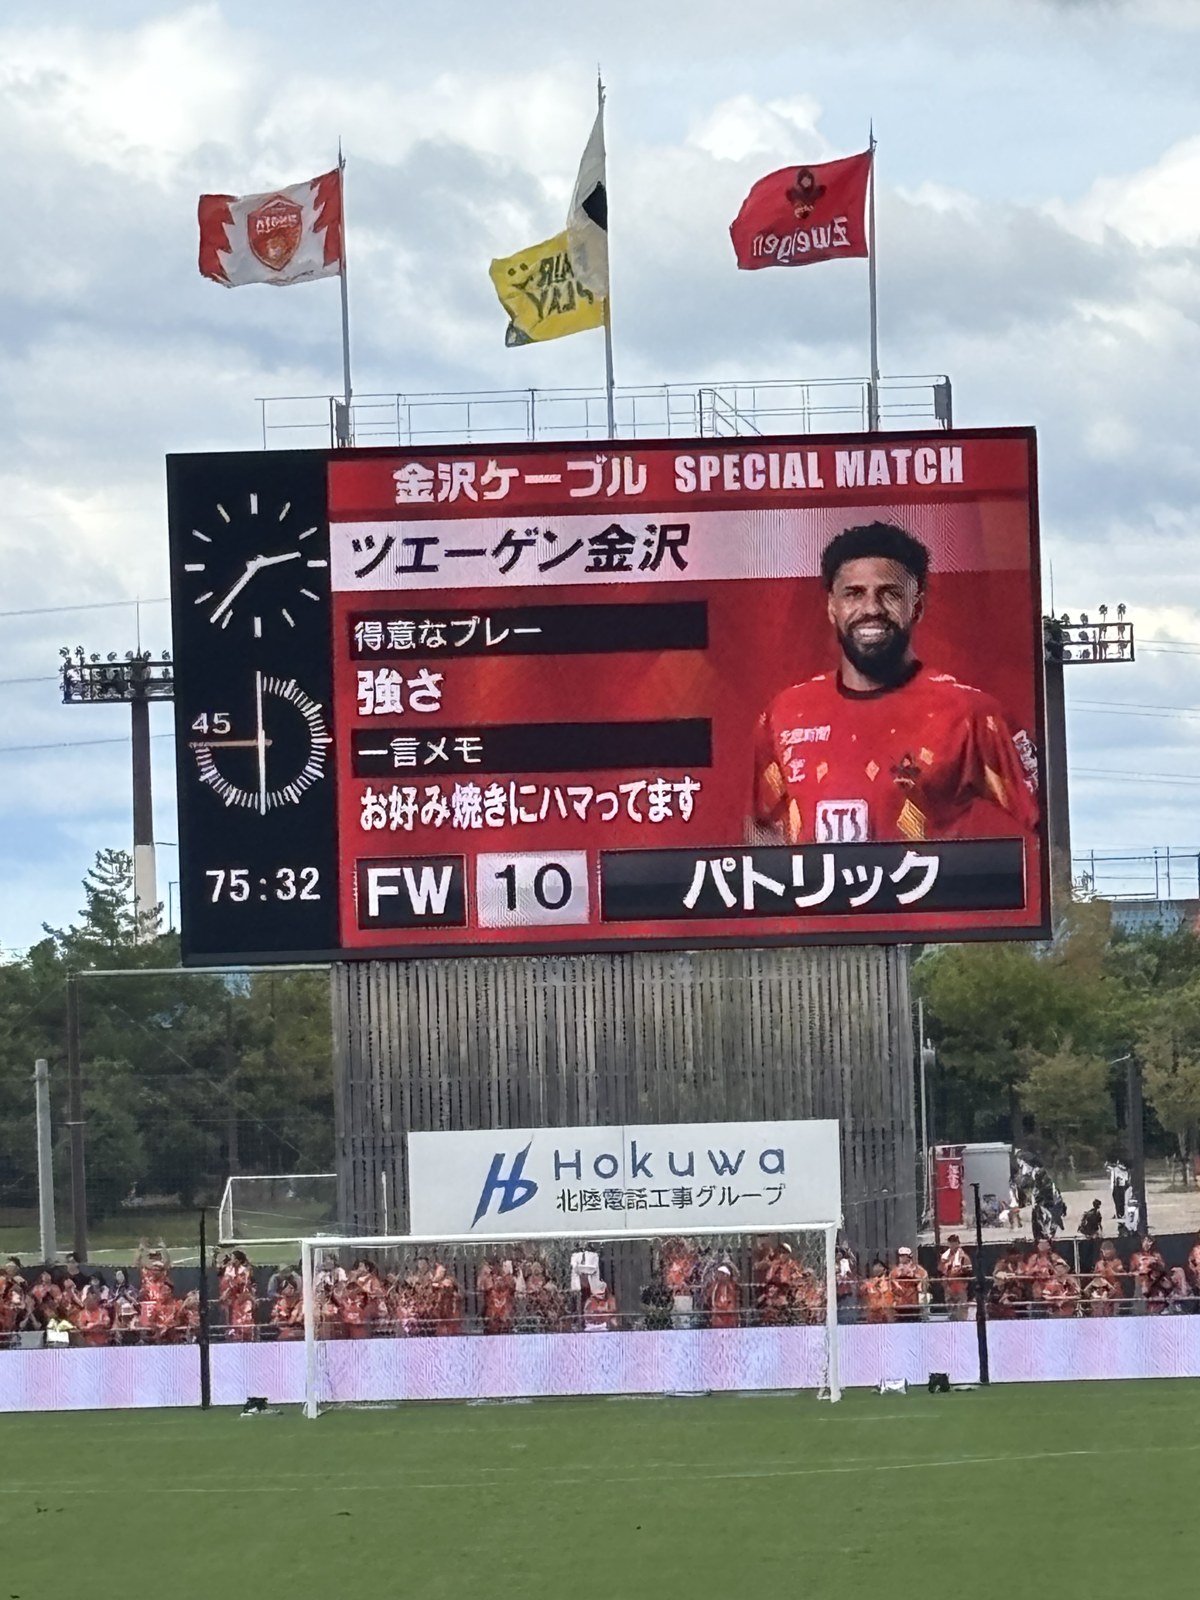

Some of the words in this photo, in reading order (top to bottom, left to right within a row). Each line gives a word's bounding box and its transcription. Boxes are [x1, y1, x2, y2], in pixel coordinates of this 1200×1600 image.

[393, 454, 648, 504] 金沢ケーブル
[674, 453, 824, 493] SPECIAL
[834, 446, 964, 488] MATCH
[351, 522, 692, 578] ツエーゲン金沢
[354, 615, 543, 652] 得意なプレー
[357, 668, 445, 716] 強さ
[191, 712, 232, 735] 45
[358, 736, 484, 768] 一言メモ
[360, 775, 702, 831] お好み焼きにハマってます
[821, 807, 862, 841] STS
[205, 867, 321, 903] 75:32
[367, 865, 453, 917] FW
[494, 862, 573, 912] 10
[684, 850, 940, 911] パトリック
[554, 1140, 786, 1181] Hokuwa
[556, 1183, 786, 1213] 北陸電話工事グループ
